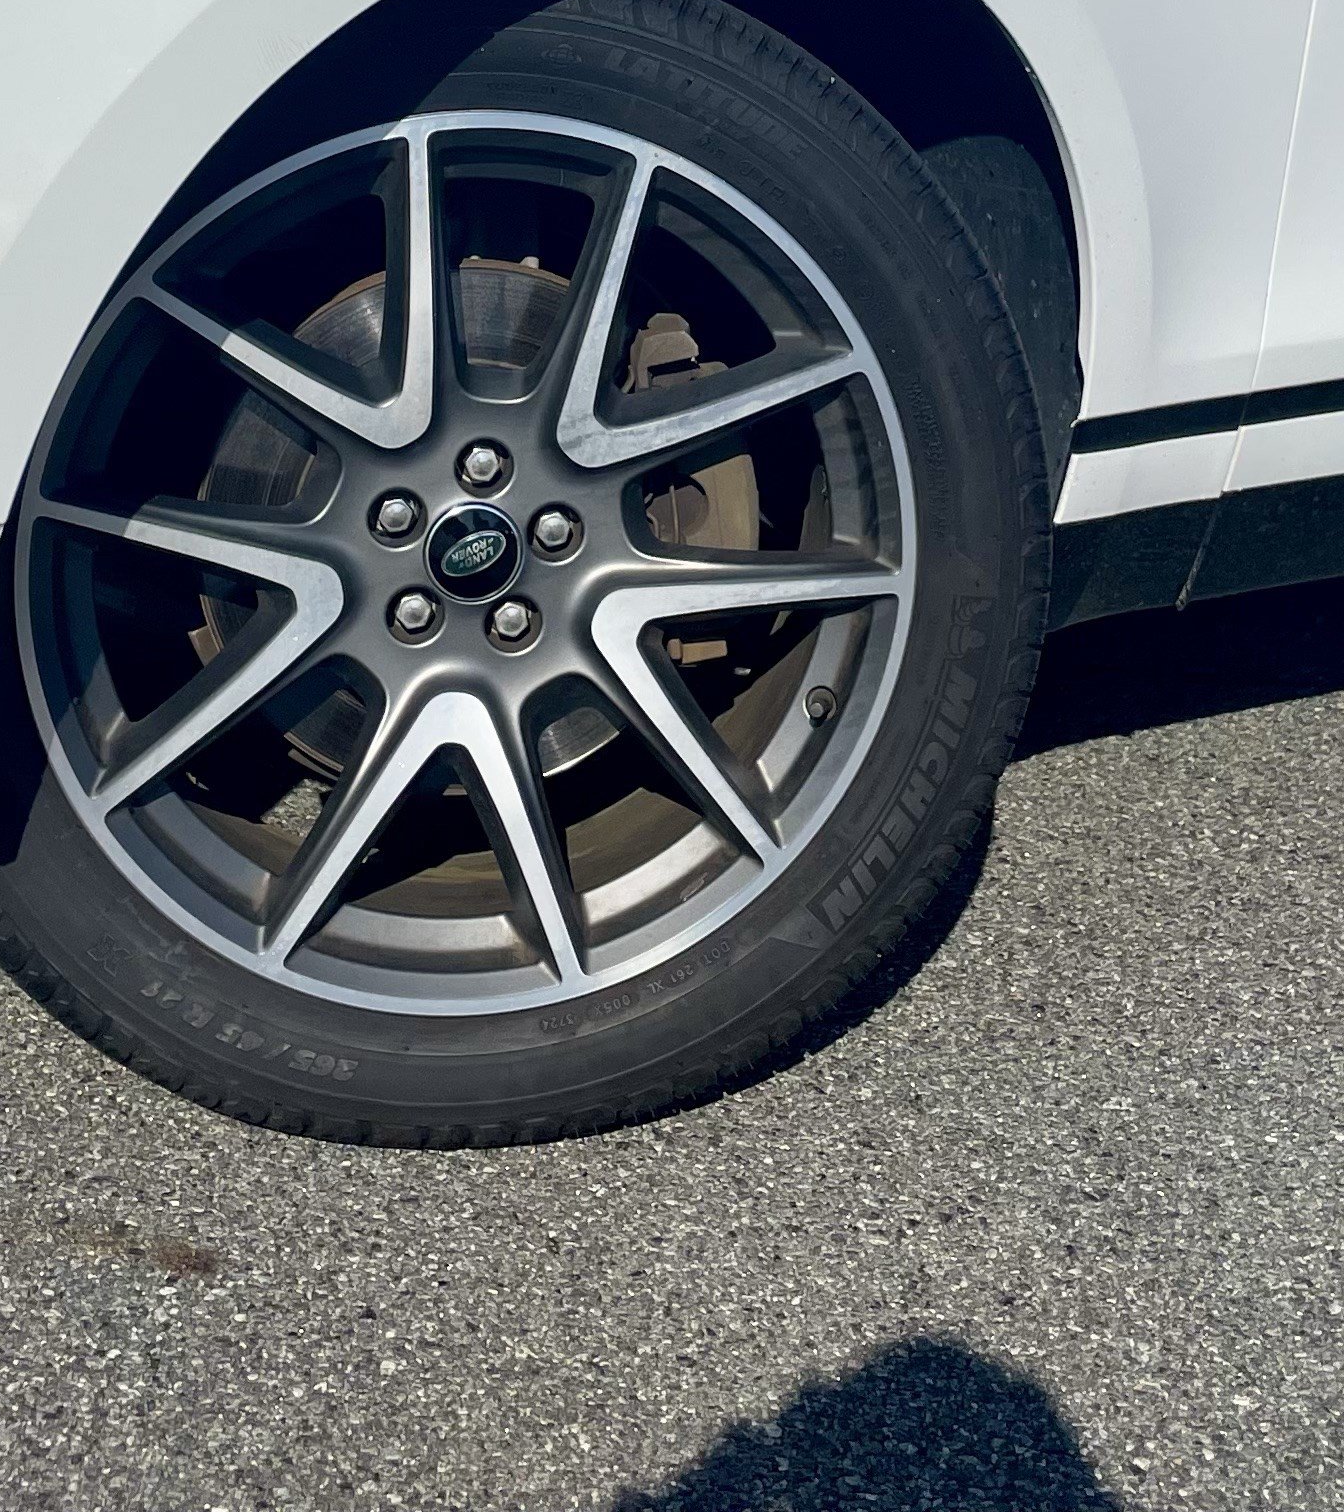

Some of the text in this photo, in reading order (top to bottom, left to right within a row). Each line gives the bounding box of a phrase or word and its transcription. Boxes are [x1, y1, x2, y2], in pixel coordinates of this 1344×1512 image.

[452, 538, 487, 563] ROVER
[465, 546, 494, 567] LAND
[820, 666, 982, 932] MICHELIN
